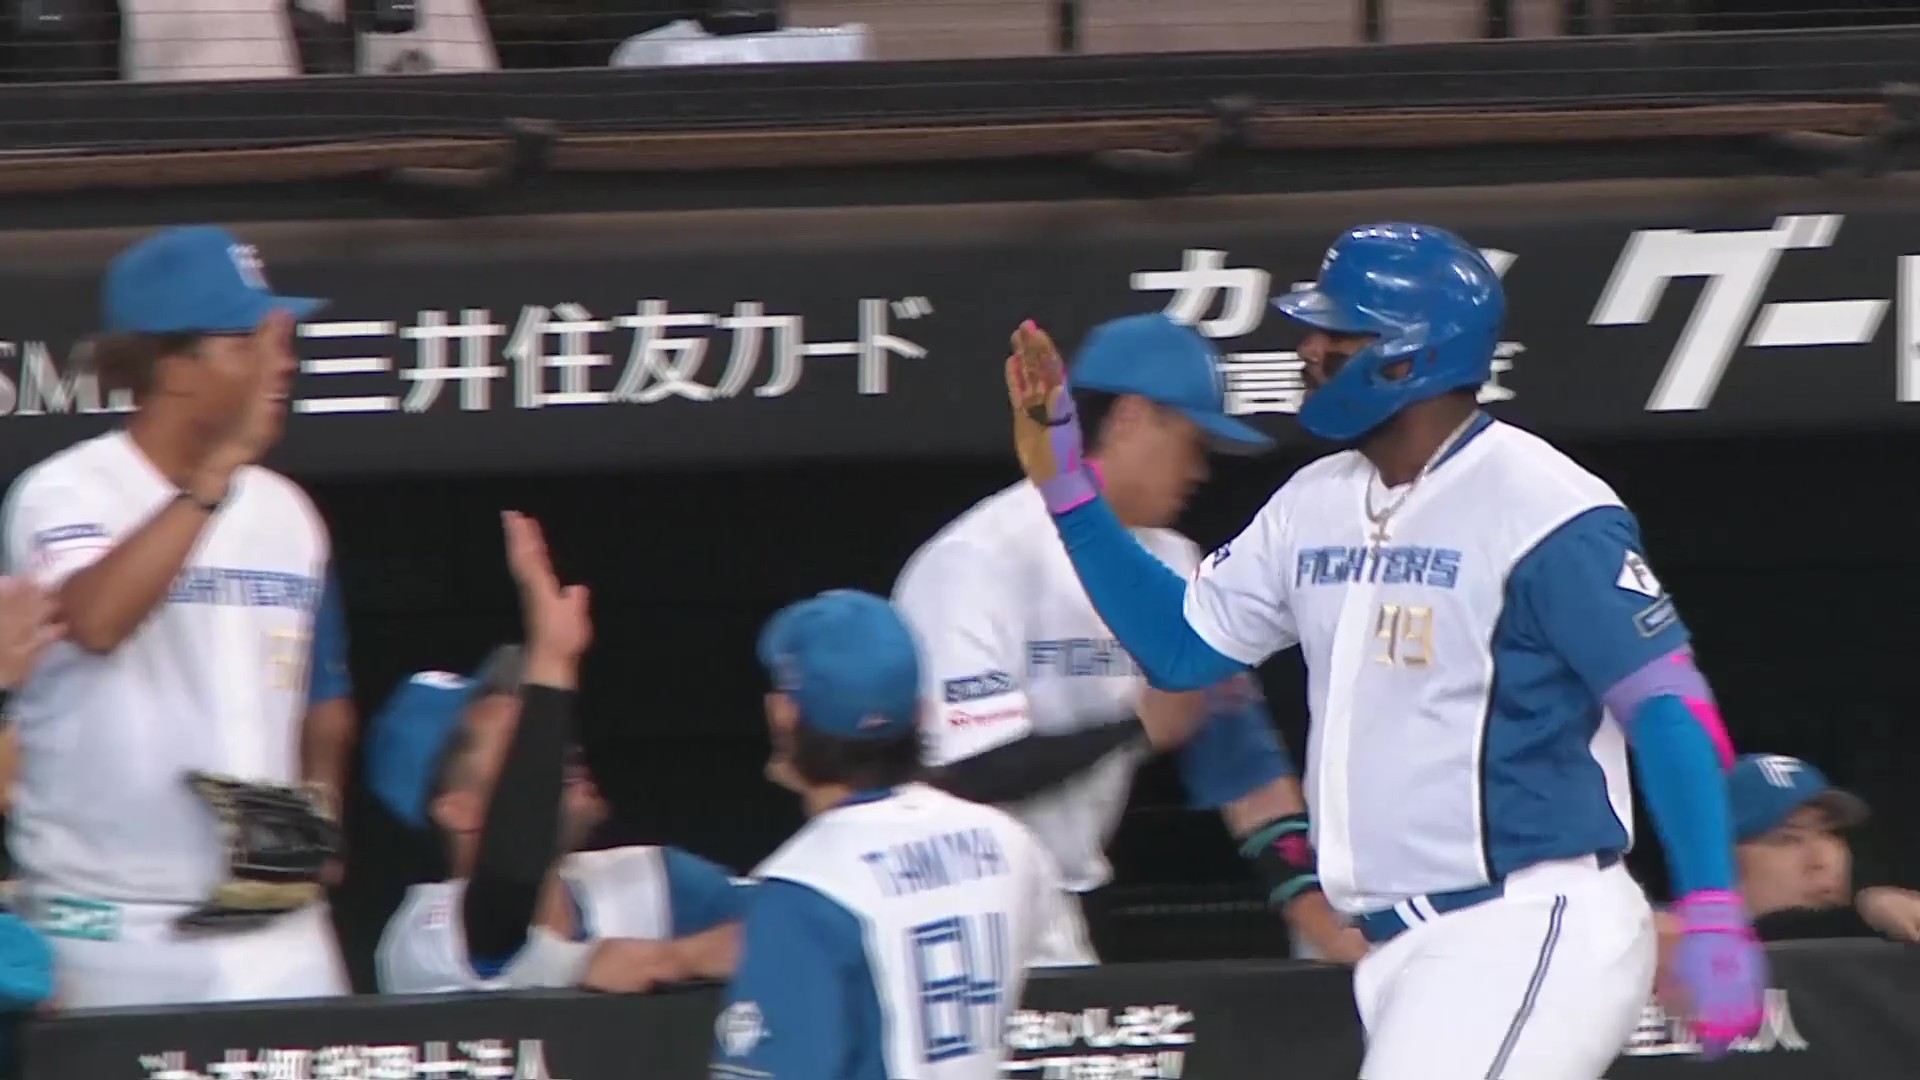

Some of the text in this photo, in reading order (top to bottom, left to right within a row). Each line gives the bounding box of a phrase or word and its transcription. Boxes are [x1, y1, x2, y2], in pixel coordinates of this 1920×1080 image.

[296, 296, 933, 413] 三井住友カード
[1296, 546, 1463, 590] FIGHTERS
